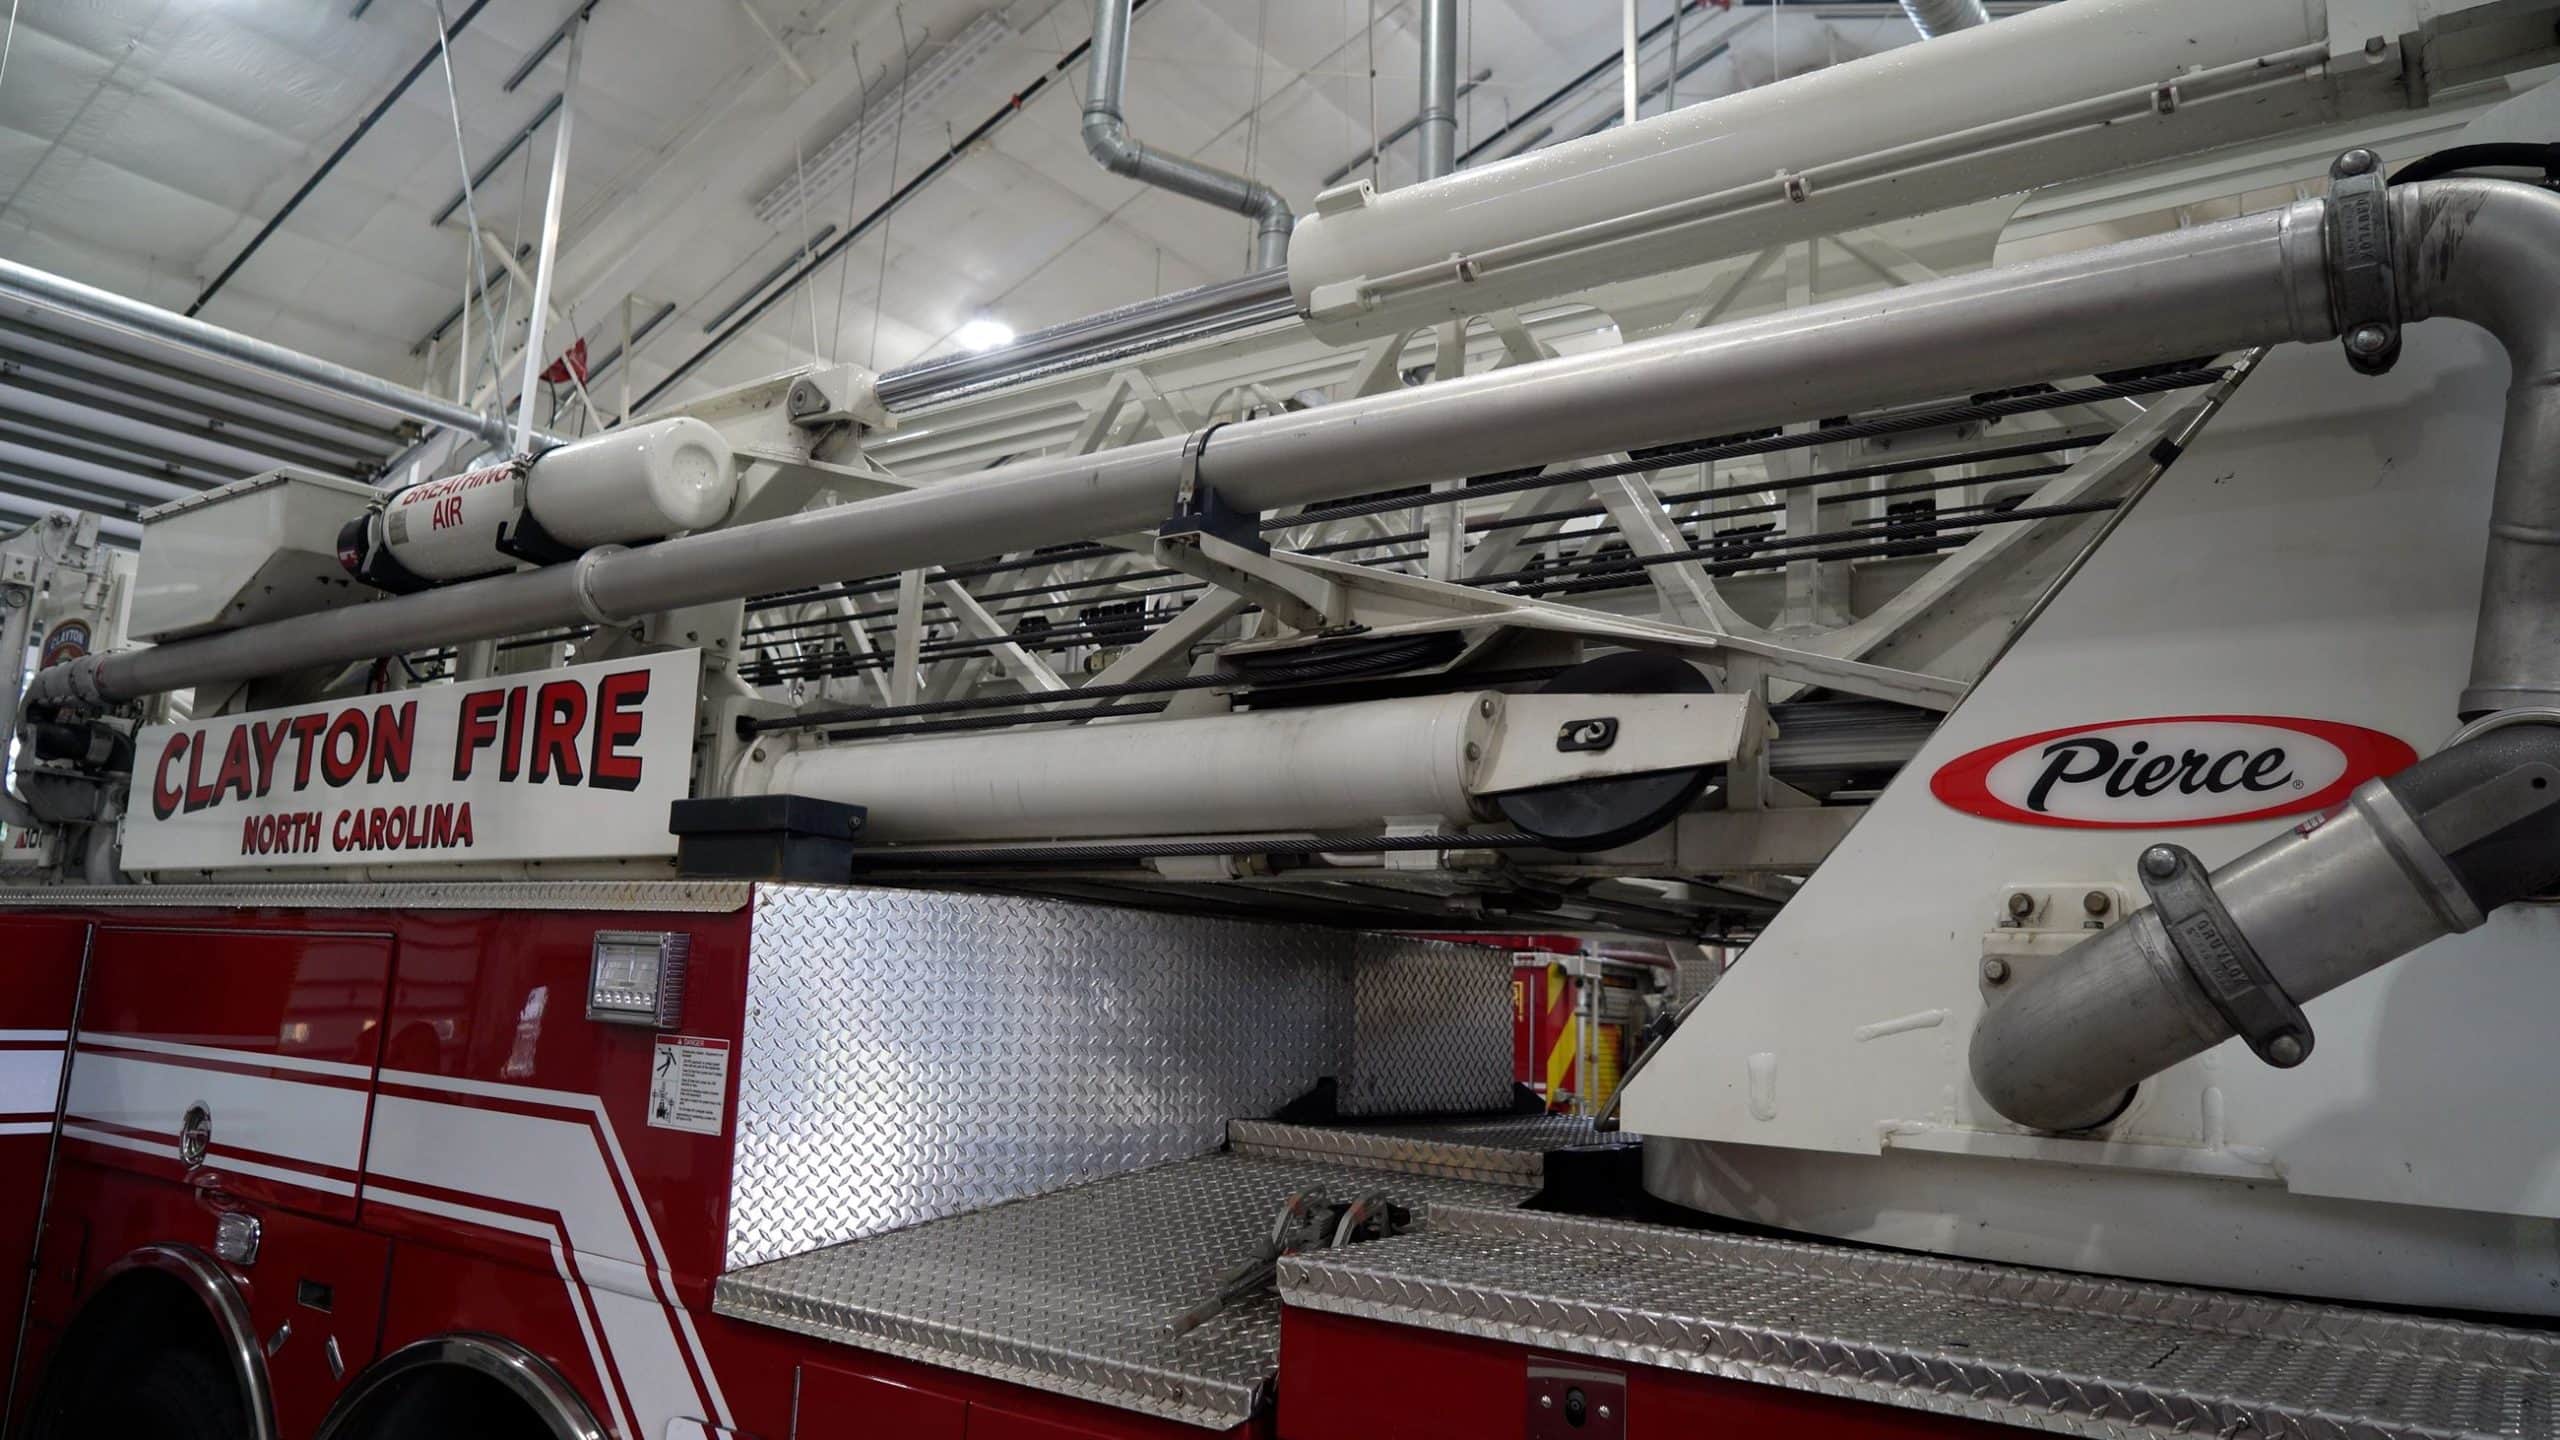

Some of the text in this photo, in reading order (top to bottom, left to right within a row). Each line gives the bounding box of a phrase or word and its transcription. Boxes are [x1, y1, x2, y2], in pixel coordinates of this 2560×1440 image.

[433, 496, 463, 531] AIR
[153, 669, 651, 821] CLAYTON FIRE
[2026, 737, 2295, 812] Pierce
[241, 802, 474, 855] NORTH CAROLINA
